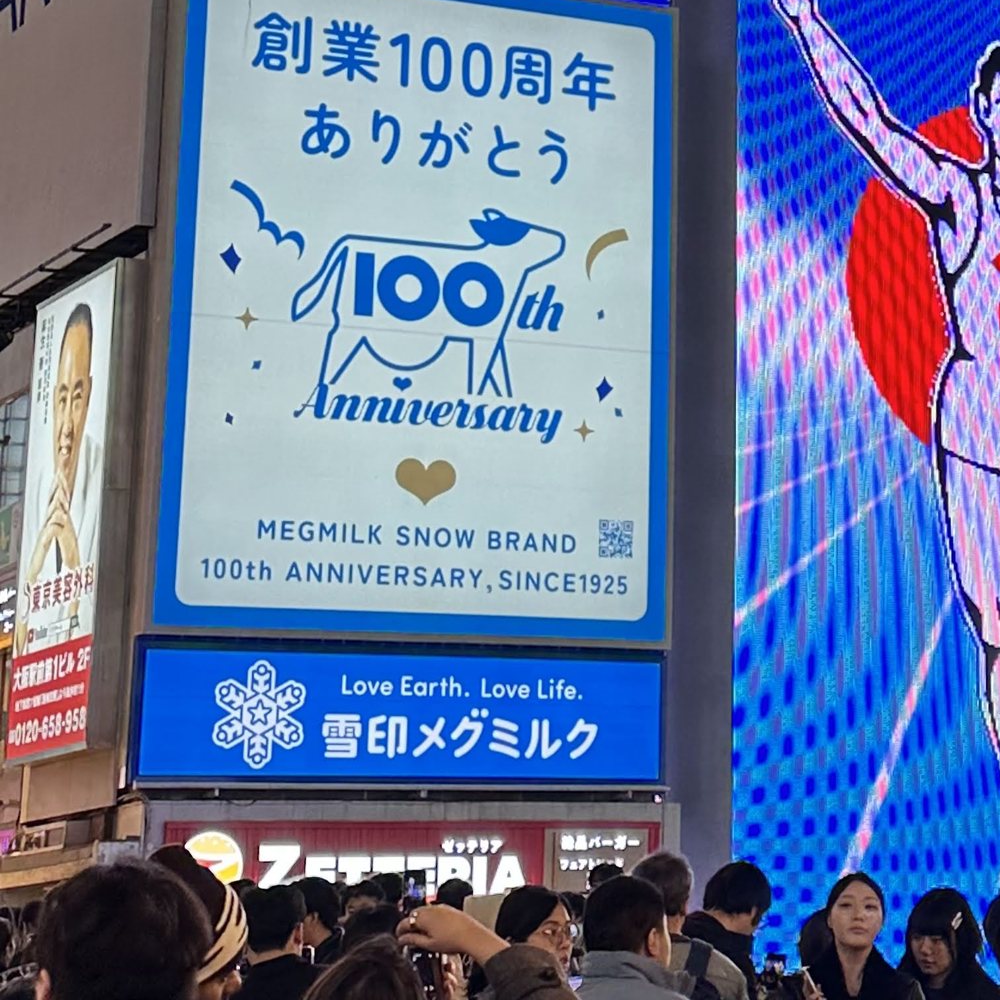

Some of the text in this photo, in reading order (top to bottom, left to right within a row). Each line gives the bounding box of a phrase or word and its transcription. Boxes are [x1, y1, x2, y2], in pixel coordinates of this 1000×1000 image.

[252, 12, 616, 111] 創業100周年
[301, 103, 569, 185] ありがとう
[293, 383, 564, 443] Anniversary
[257, 519, 577, 555] MEGMILK SNOW BRAND
[201, 557, 272, 582] 100th
[341, 674, 583, 700] Love Earth. Love Life.
[322, 708, 598, 760] 雪印メグミルク
